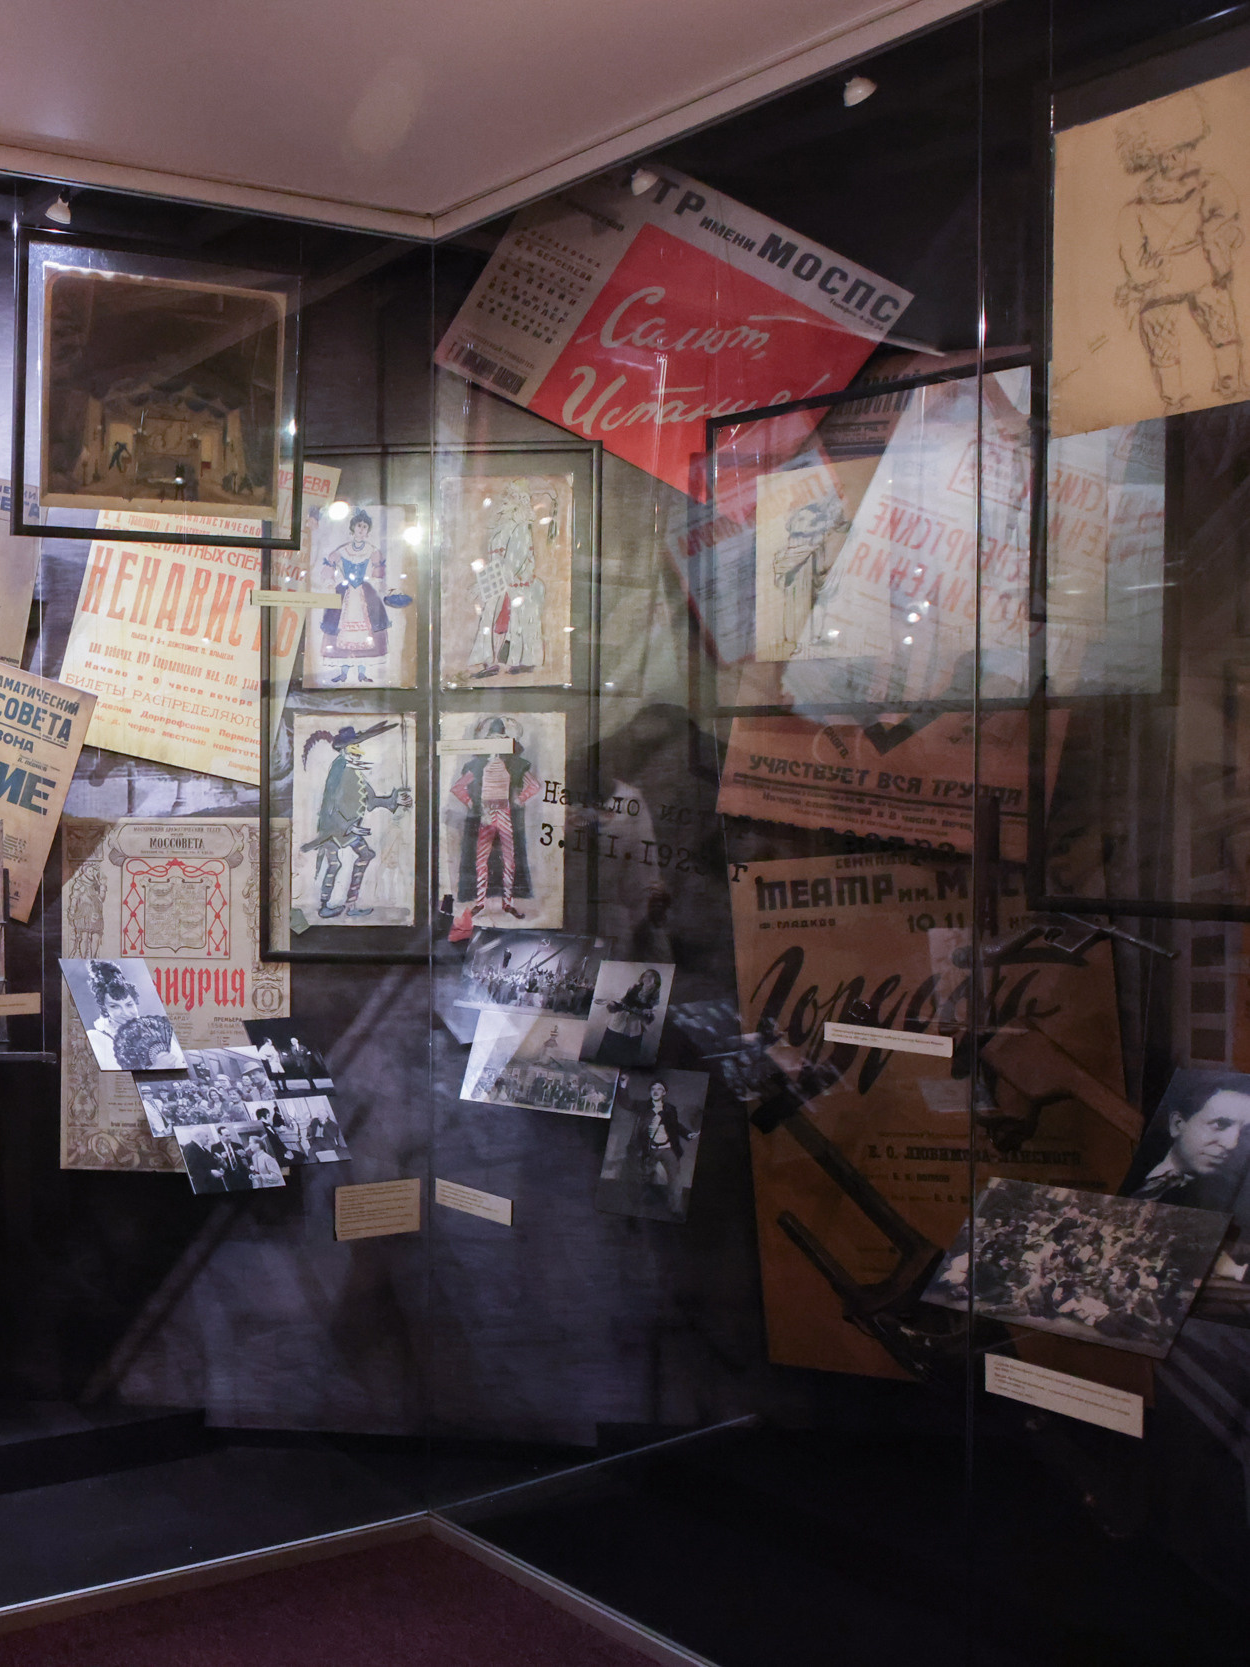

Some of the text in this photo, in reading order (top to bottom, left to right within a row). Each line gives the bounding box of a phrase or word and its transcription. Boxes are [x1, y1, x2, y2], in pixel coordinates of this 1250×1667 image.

[699, 215, 900, 324] ИМЕНИ МОСПС
[600, 285, 768, 361] Салют,
[80, 544, 299, 660] НЕНАВИСЬ
[65, 672, 127, 697] БИЛЕТЫ
[84, 661, 129, 679] Начало
[168, 682, 204, 697] часов
[209, 691, 254, 708] вечера
[127, 720, 157, 735] через
[161, 729, 207, 747] местные
[749, 754, 870, 788] УЧАСТВУЕТ
[876, 770, 923, 797] ВСЯ
[149, 836, 206, 850] МОССОВЕТА
[776, 917, 837, 930] ГЛАДКОВ
[213, 1015, 244, 1024] ПРЕМЬЕРА
